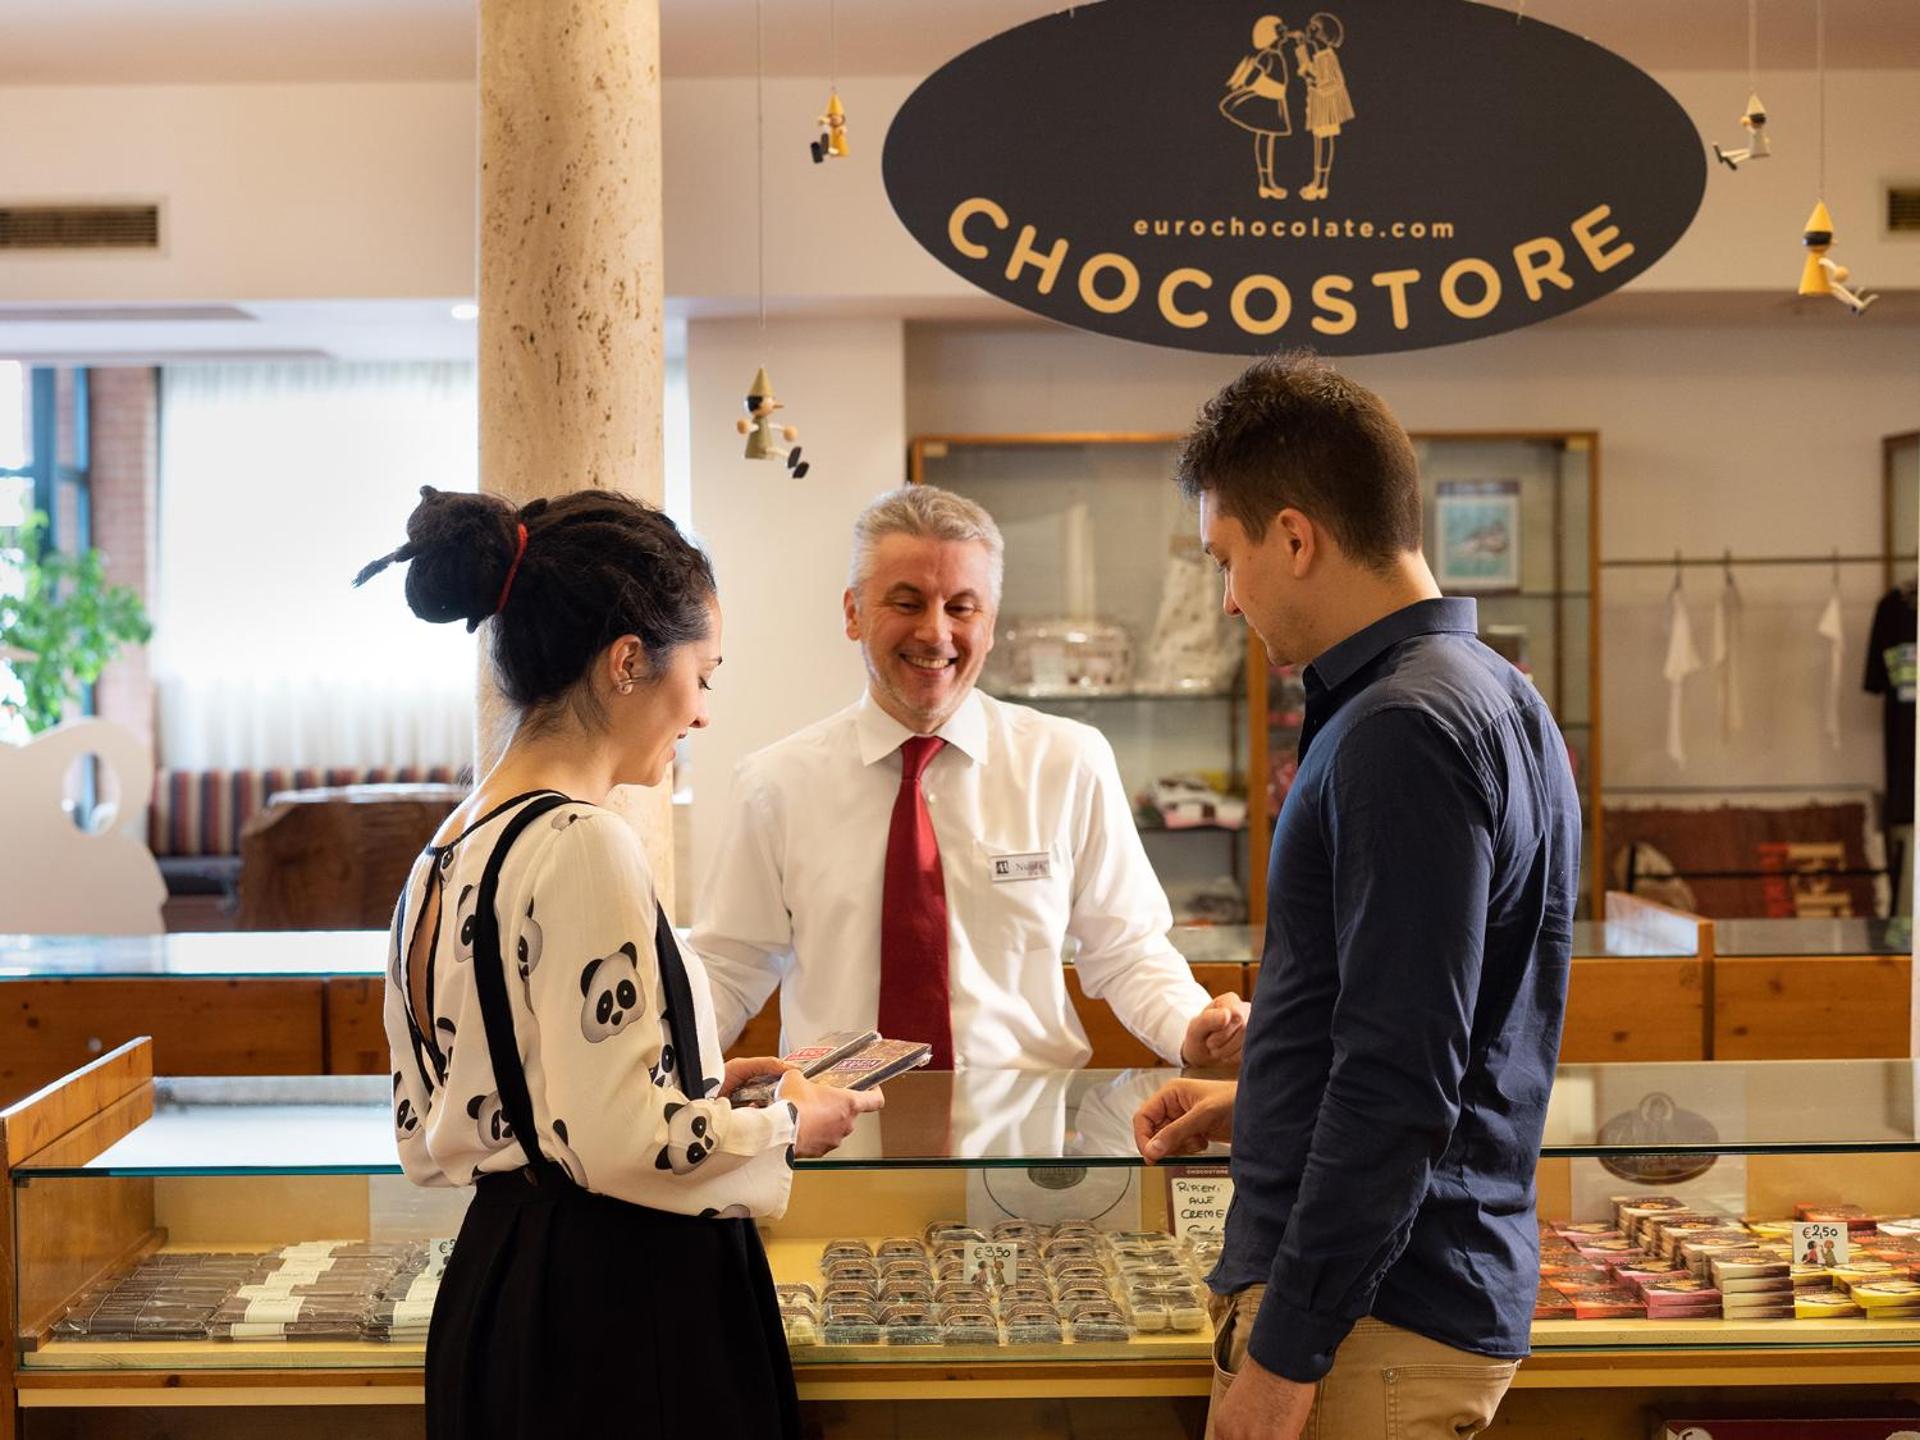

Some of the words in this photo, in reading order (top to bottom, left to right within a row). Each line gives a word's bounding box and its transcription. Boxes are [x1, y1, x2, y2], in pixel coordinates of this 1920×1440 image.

[1133, 219, 1455, 239] eurochocolate.com
[948, 197, 1636, 335] CHOCOSTORE
[1181, 1208, 1224, 1220] CREME
[1802, 1224, 1838, 1240] €2,50
